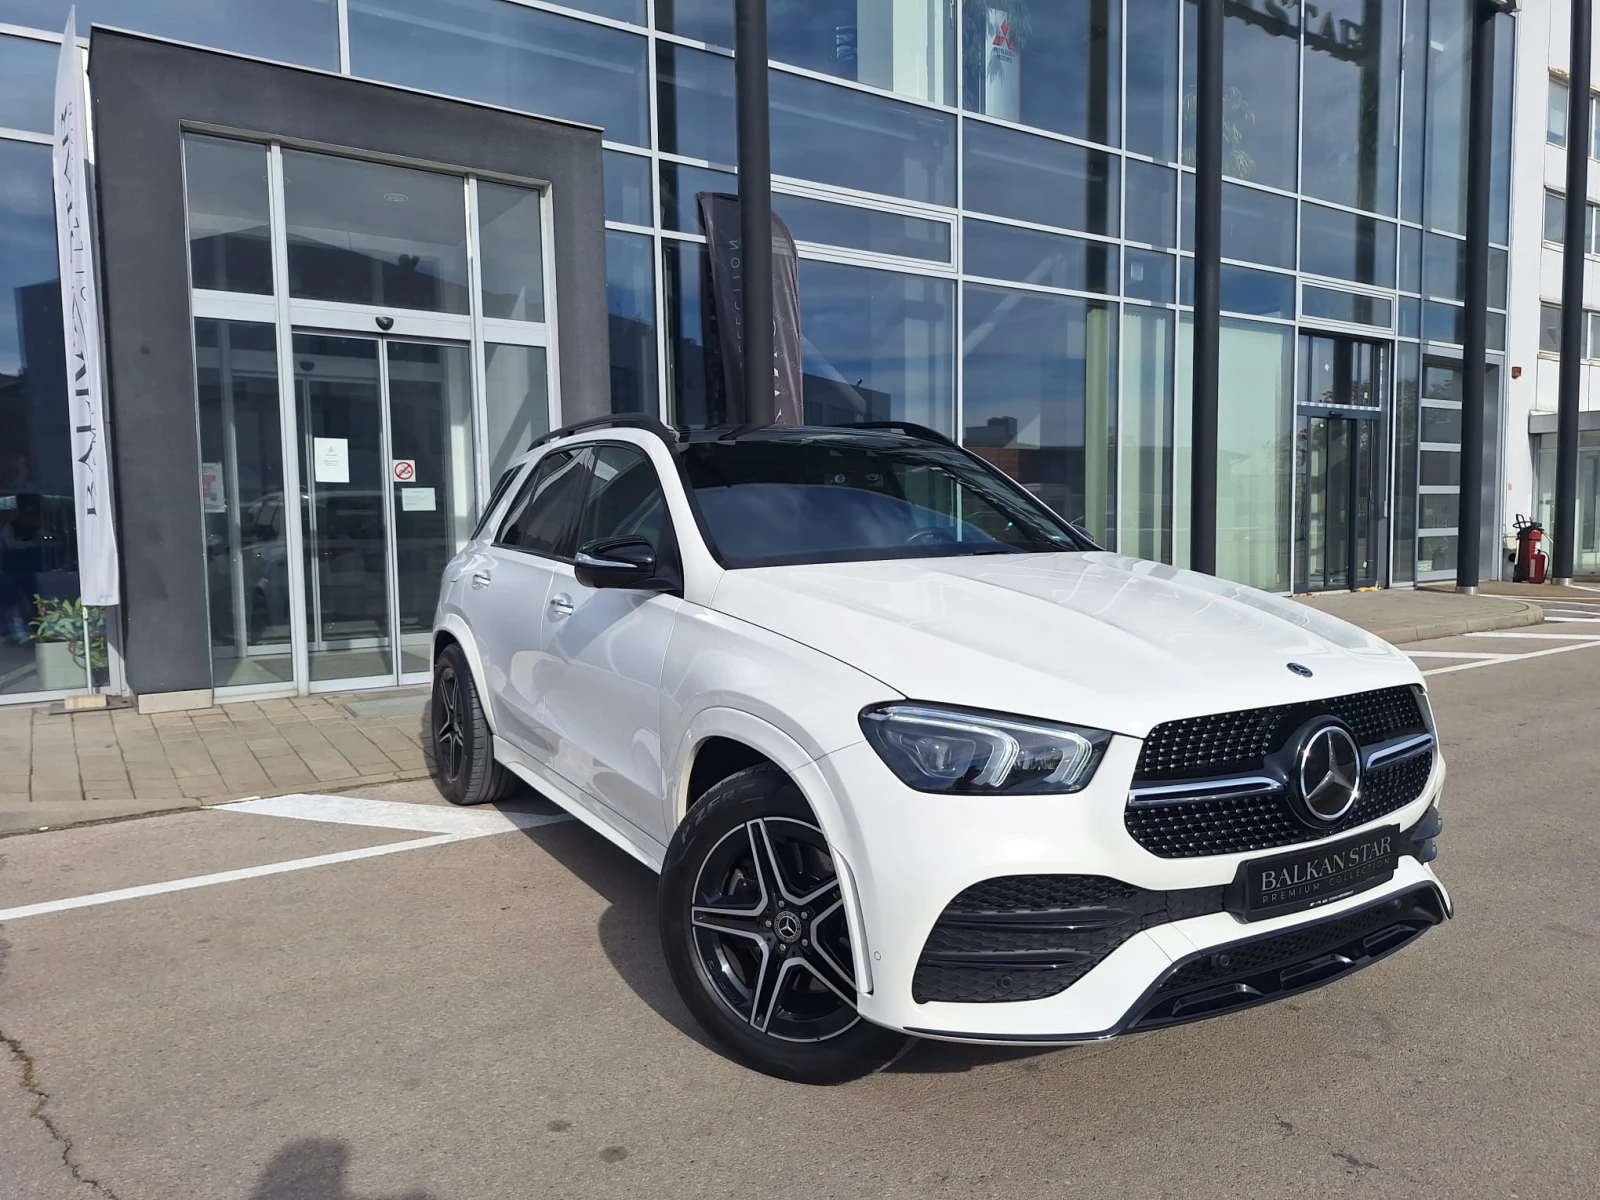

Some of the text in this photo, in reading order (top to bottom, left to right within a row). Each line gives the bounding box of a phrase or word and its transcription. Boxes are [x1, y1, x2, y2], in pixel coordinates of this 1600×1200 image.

[1261, 836, 1391, 891] BALKAN STAR
[1262, 883, 1320, 904] PREMIUM
[1329, 858, 1390, 886] COLLECTION
